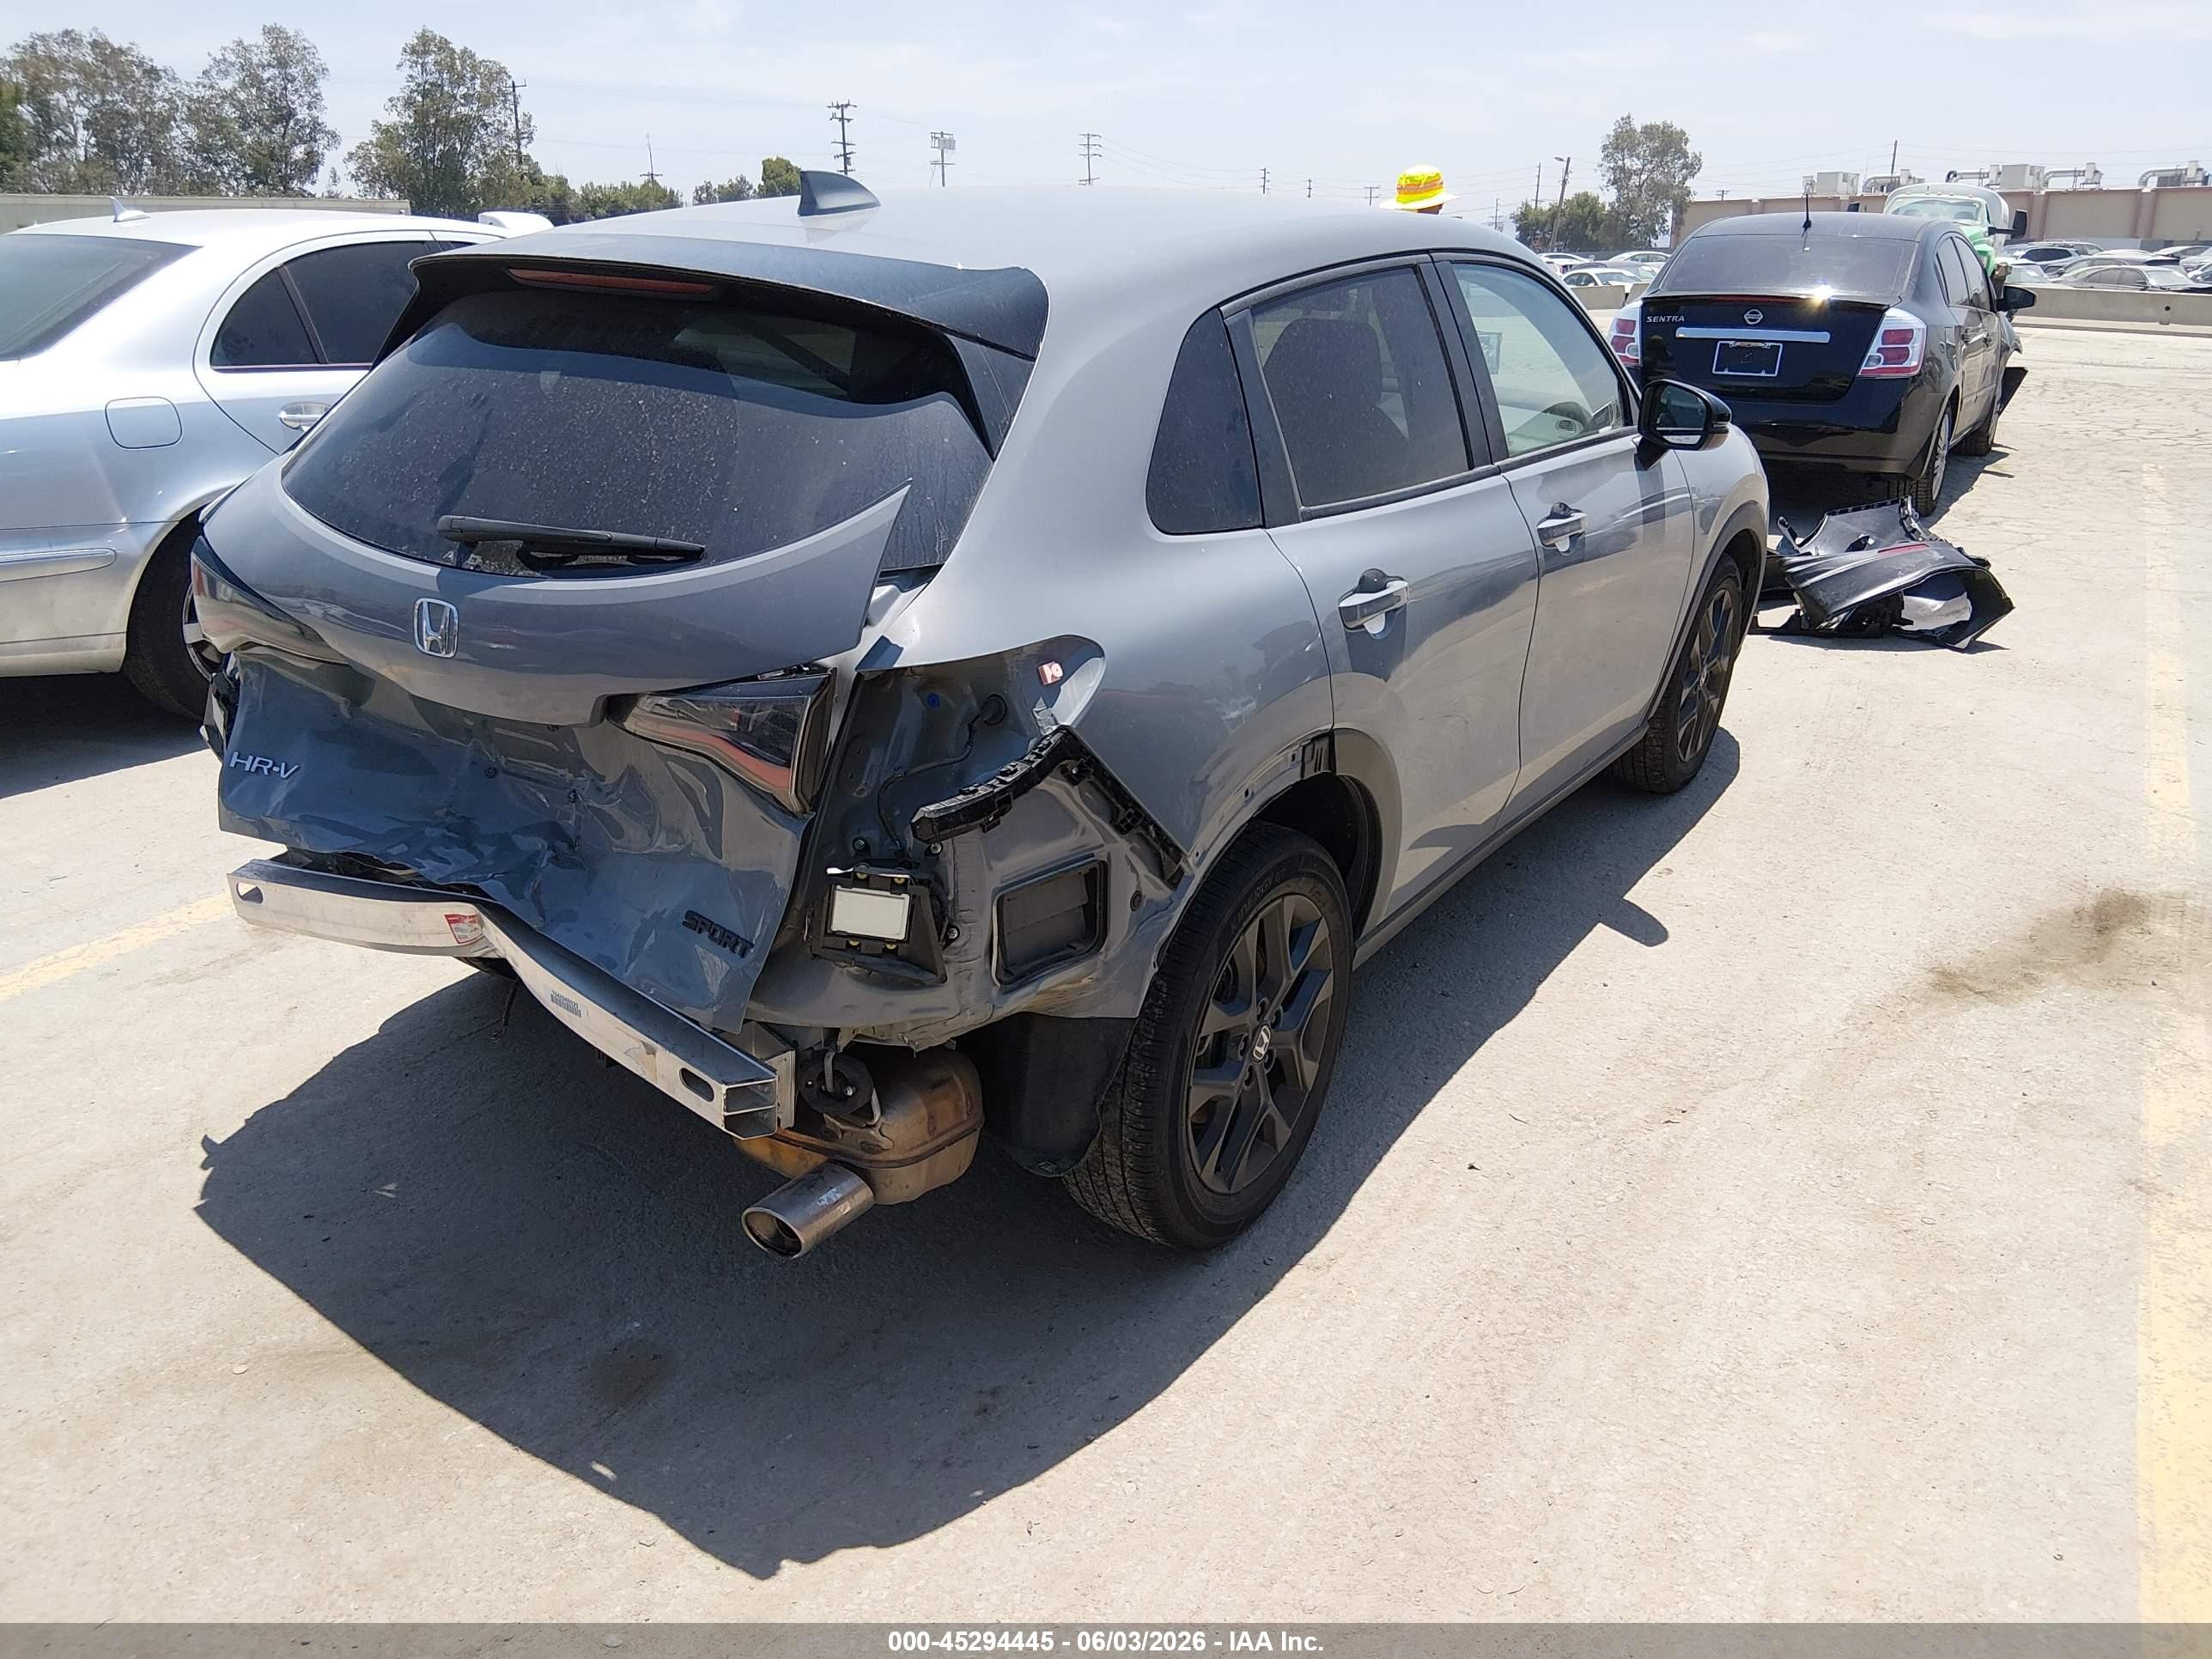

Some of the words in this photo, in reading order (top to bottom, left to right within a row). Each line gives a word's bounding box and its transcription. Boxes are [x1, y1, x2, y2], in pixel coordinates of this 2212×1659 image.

[1645, 314, 1685, 323] SENTRA
[228, 750, 301, 779] HR-V
[681, 908, 755, 958] SPORT
